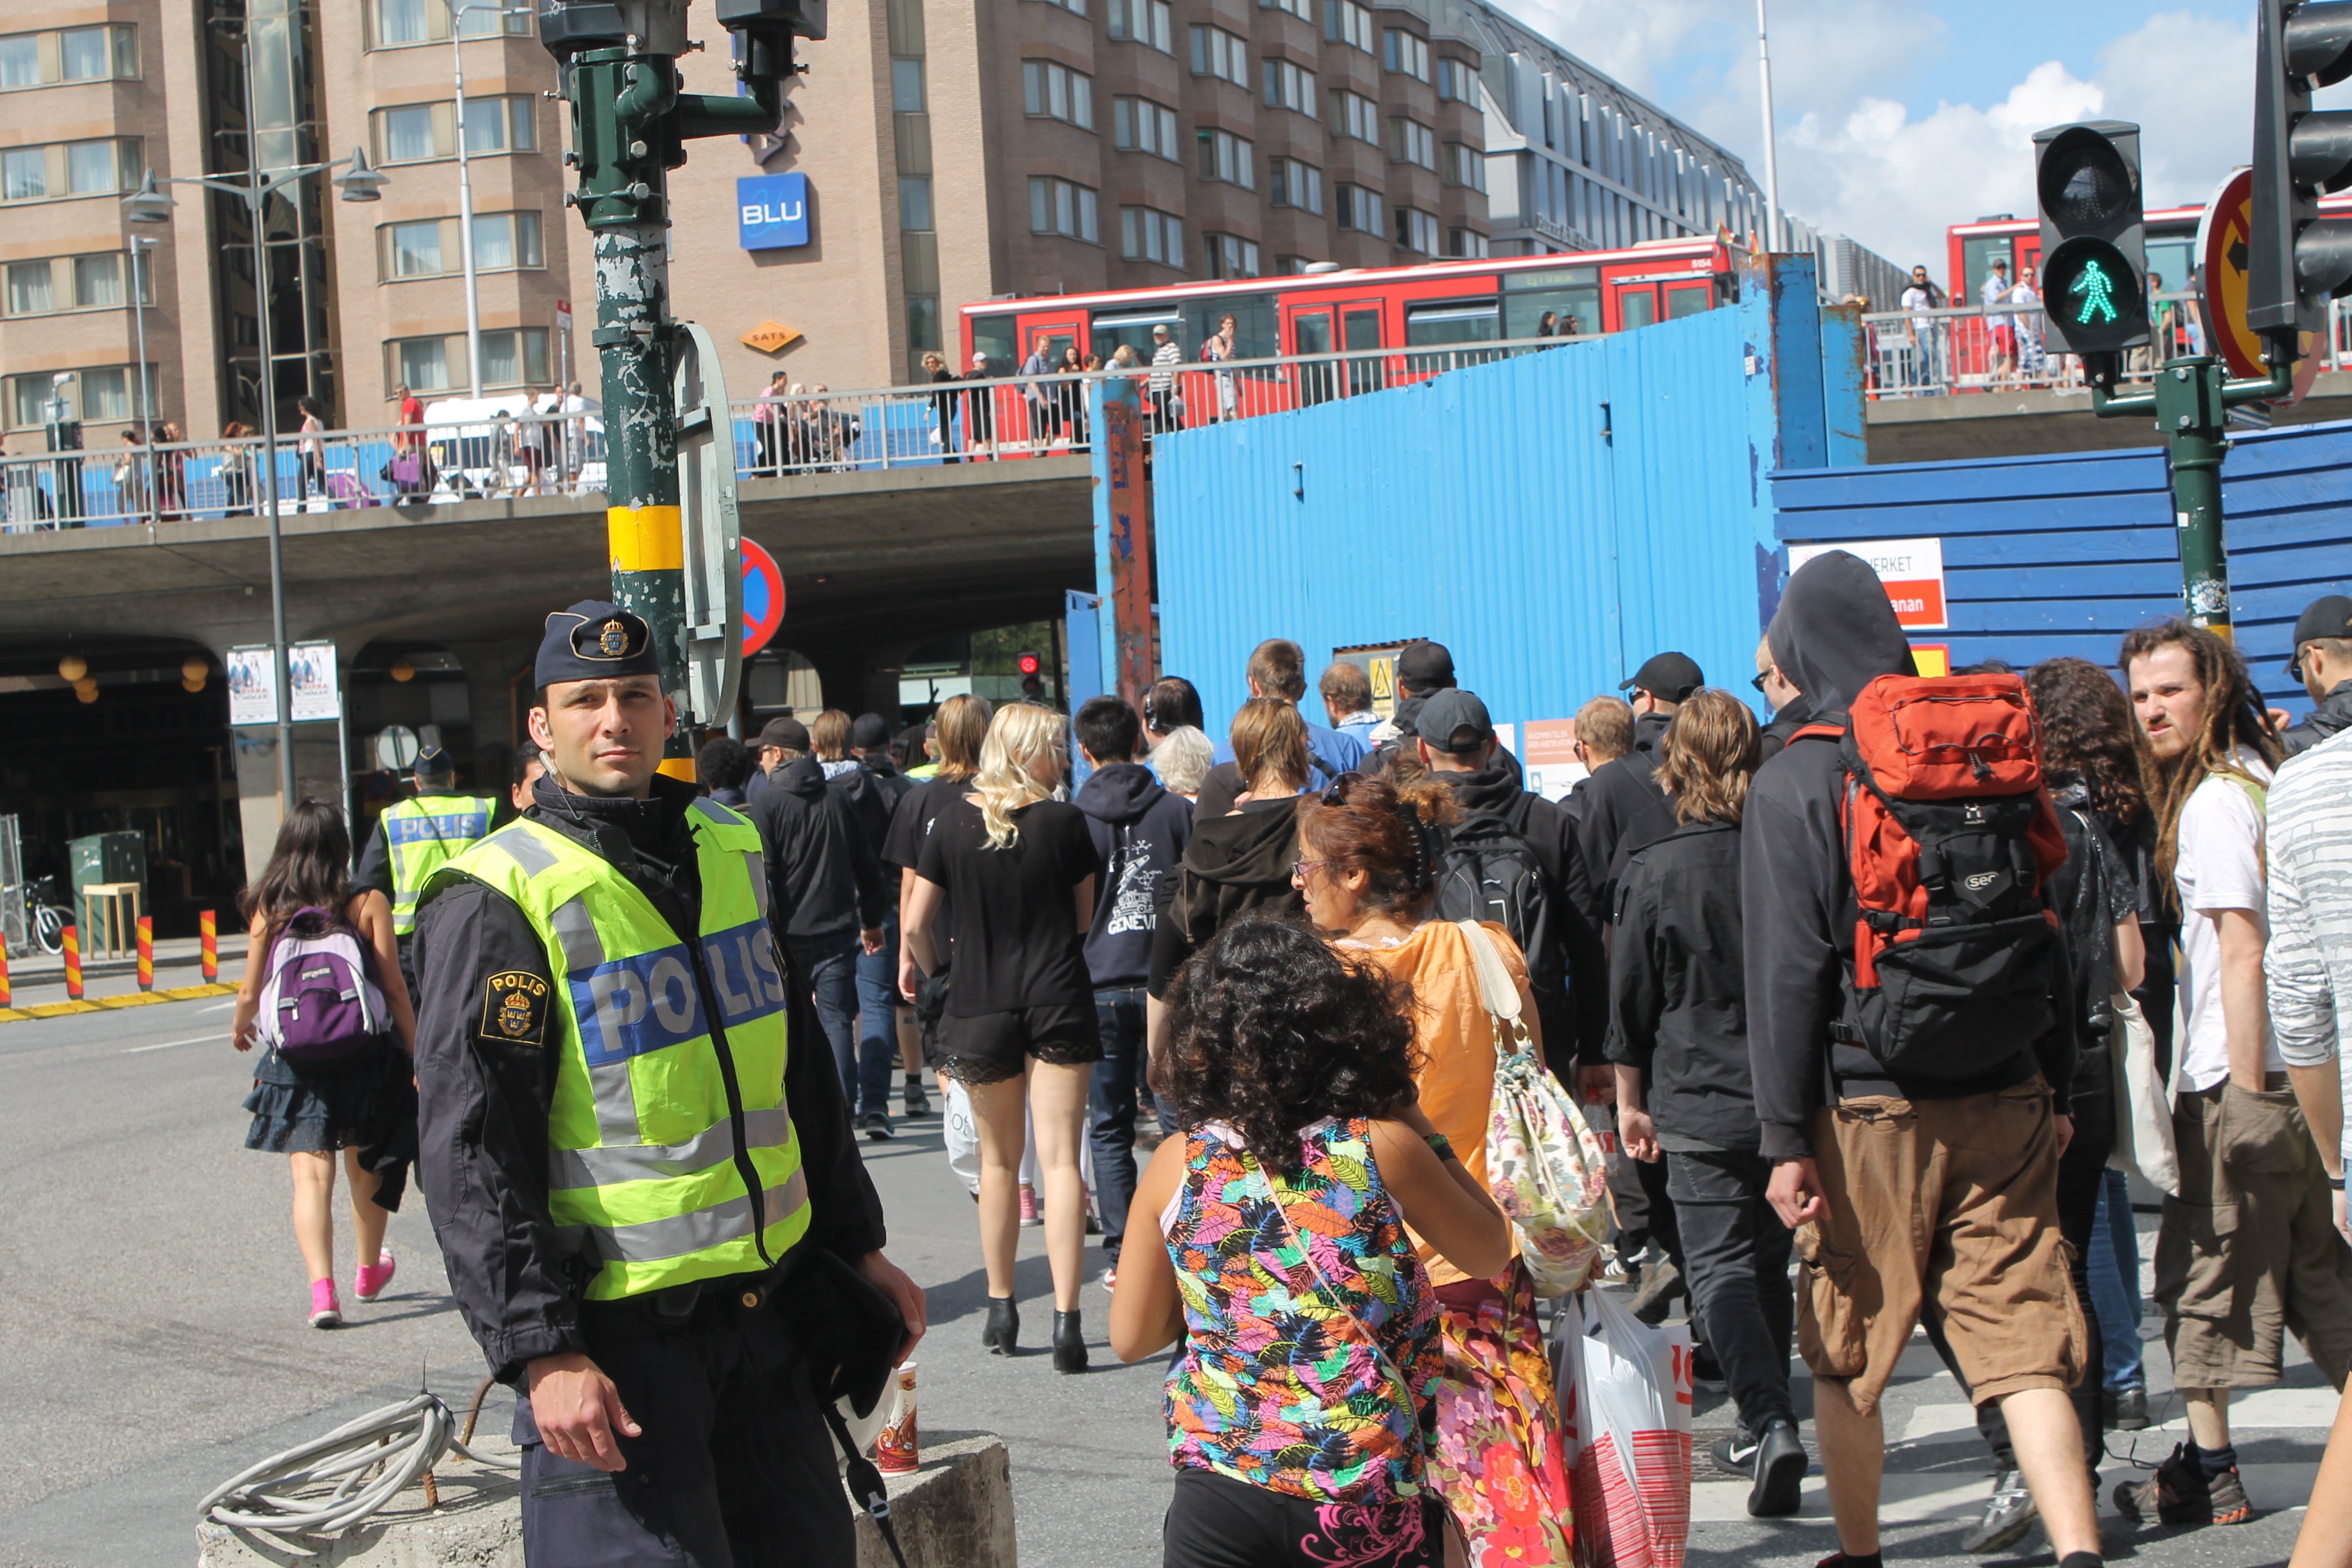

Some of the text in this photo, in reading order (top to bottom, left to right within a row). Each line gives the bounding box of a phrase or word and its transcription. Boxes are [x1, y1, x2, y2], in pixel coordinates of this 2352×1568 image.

[742, 200, 802, 225] BLU
[753, 332, 785, 341] SATS
[401, 815, 476, 841] POLIS
[492, 974, 546, 997] POLIS
[589, 927, 784, 1052] POLIS
